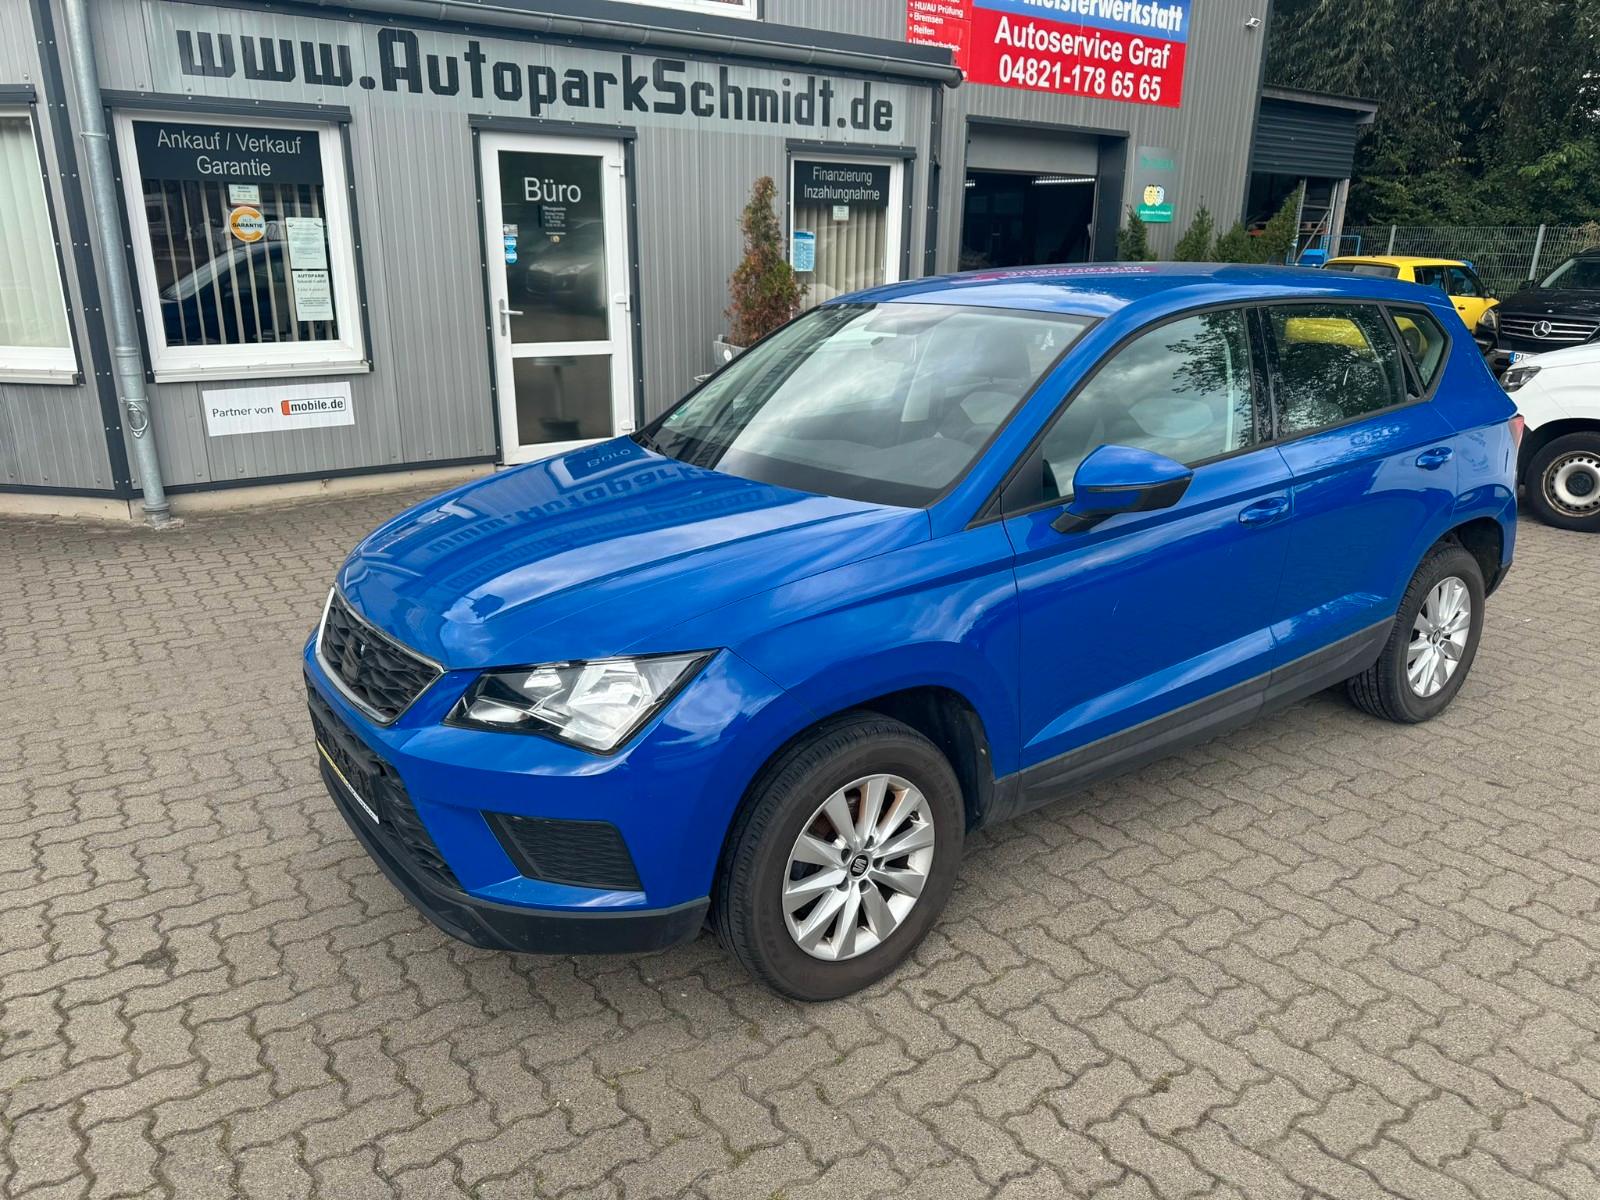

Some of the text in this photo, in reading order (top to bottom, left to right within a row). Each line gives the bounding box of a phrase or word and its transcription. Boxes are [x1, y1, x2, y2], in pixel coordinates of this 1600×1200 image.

[914, 12, 944, 24] Bremsen
[937, 5, 964, 18] Prüfung
[913, 24, 935, 36] Reifen
[994, 15, 1172, 70] Autoservice Graf
[176, 27, 893, 132] www.AutoparkSchmidt.de
[999, 54, 1162, 102] 04821-178 65 65
[157, 129, 302, 154] Ankauf / Verkauf
[196, 155, 272, 177] Garantie
[813, 166, 873, 186] Finanzierung
[524, 177, 582, 203] Büro
[804, 184, 881, 203] Inzahlungnahme
[212, 398, 344, 419] Partner von mobile.de
